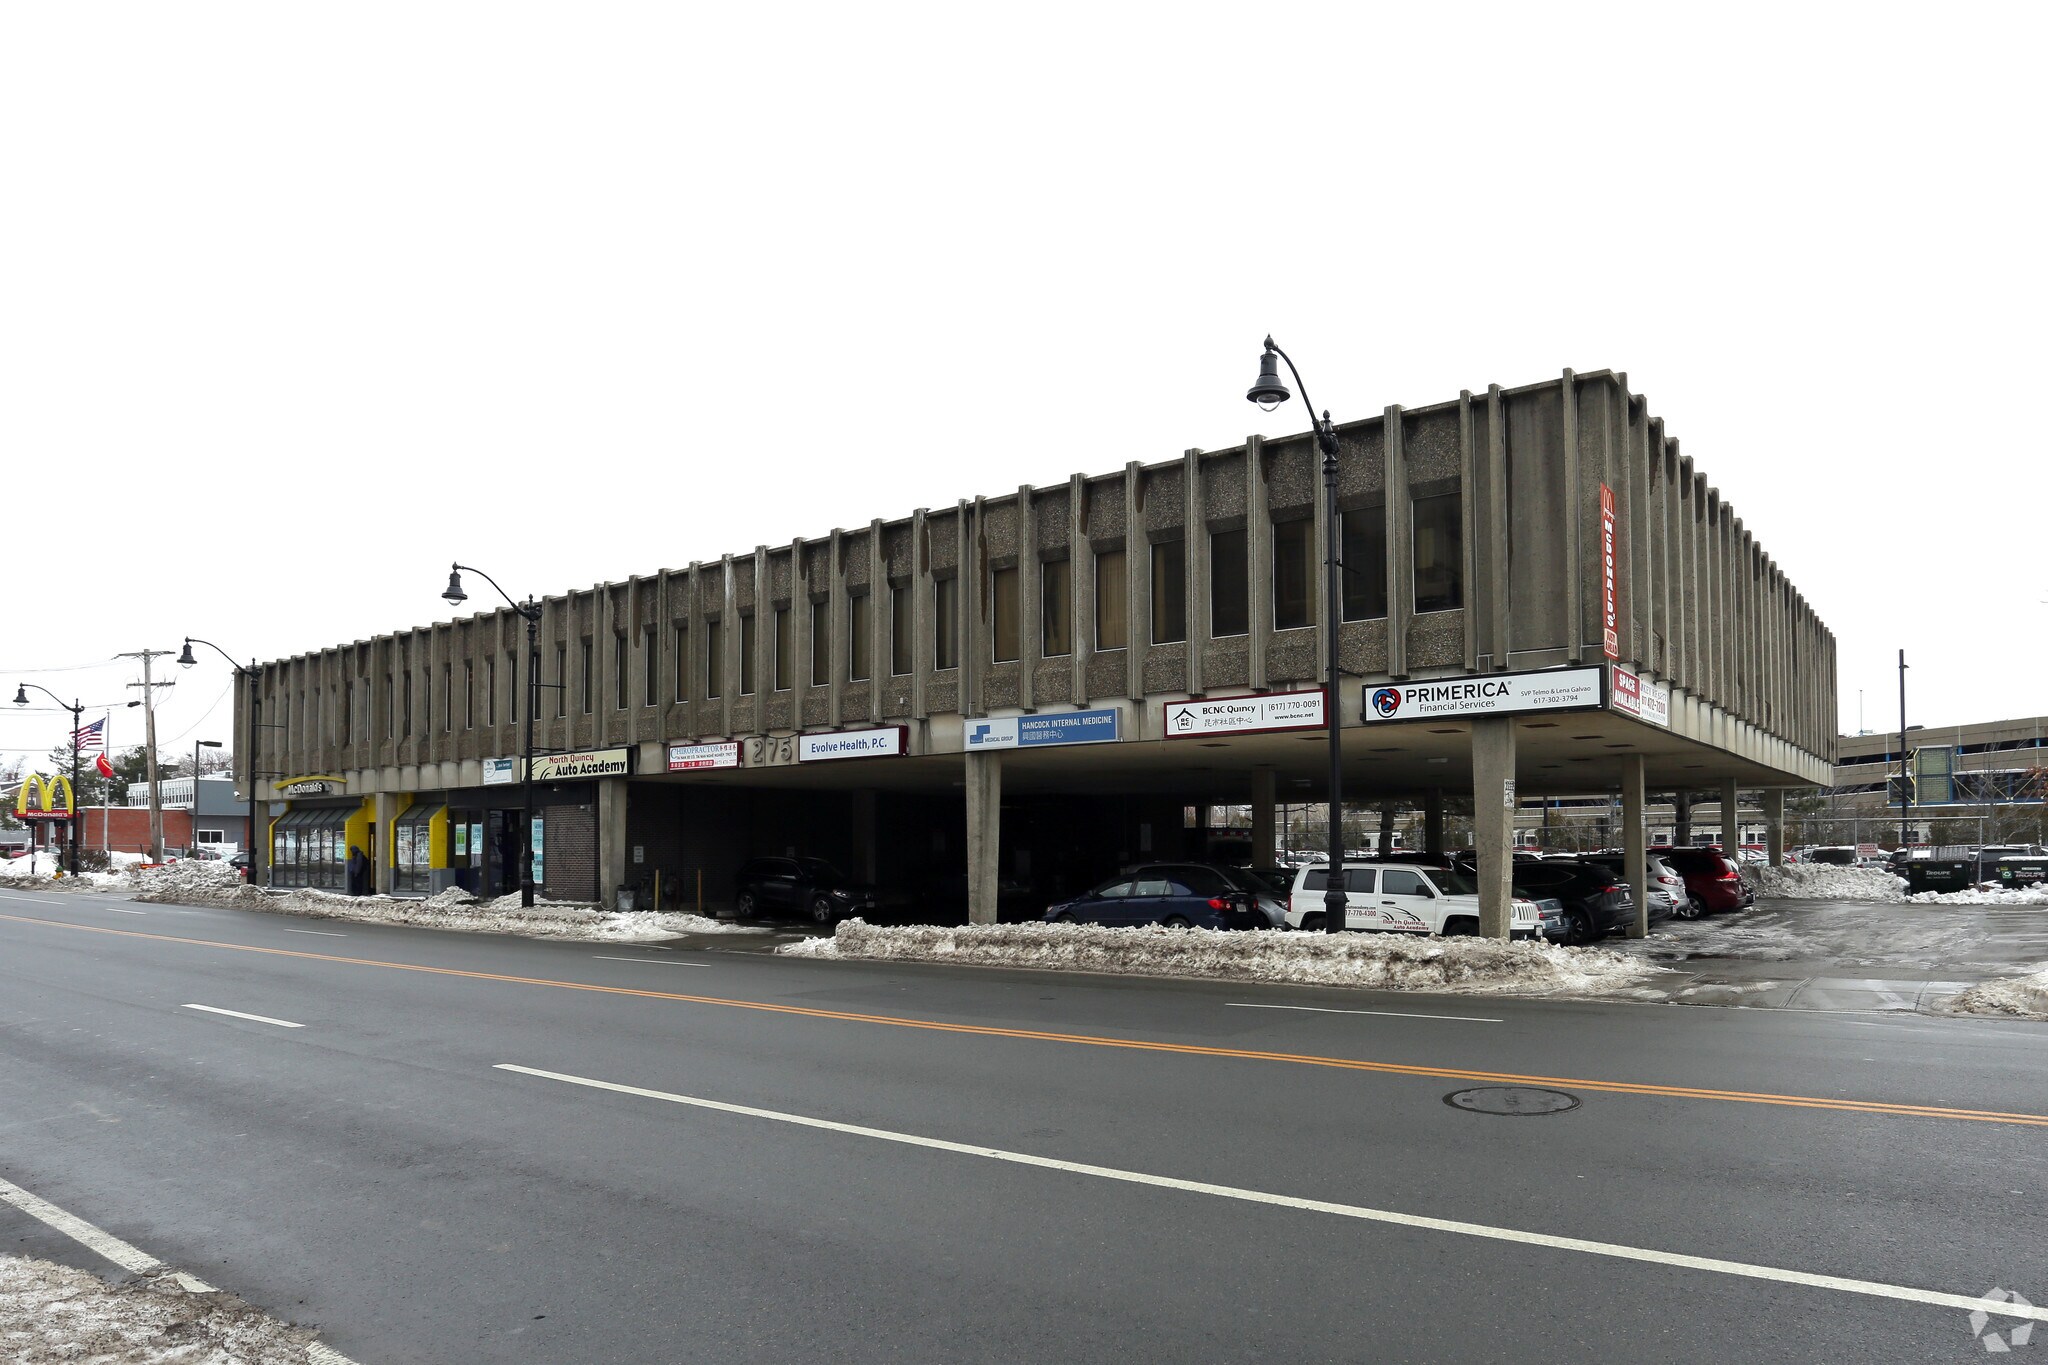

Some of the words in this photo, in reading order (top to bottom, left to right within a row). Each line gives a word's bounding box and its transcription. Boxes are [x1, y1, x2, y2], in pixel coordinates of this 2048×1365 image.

[1570, 685, 1592, 693] Galvao
[1618, 673, 1636, 693] SPACE
[1406, 681, 1510, 703] PRIMERICA
[1287, 700, 1320, 709] 770-0091
[1533, 694, 1578, 704] 617-302-3794
[1202, 705, 1226, 715] BCNC
[1226, 705, 1257, 713] Quincy
[1419, 701, 1458, 712] Financial
[1459, 700, 1496, 710] Services
[1274, 712, 1315, 720] www.bcnc.net
[1021, 720, 1050, 730] HANCOCK
[1051, 717, 1081, 728] INTERNAL
[1082, 715, 1112, 725] MEDICINE
[752, 737, 793, 763] 275
[811, 742, 838, 753] Evolve
[839, 740, 870, 752] Health,
[872, 737, 888, 749] P.C.
[548, 755, 569, 765] North
[570, 753, 594, 764] Quincy
[555, 762, 578, 776] Auto
[579, 759, 626, 775] Academy
[288, 782, 323, 794] McDonald's
